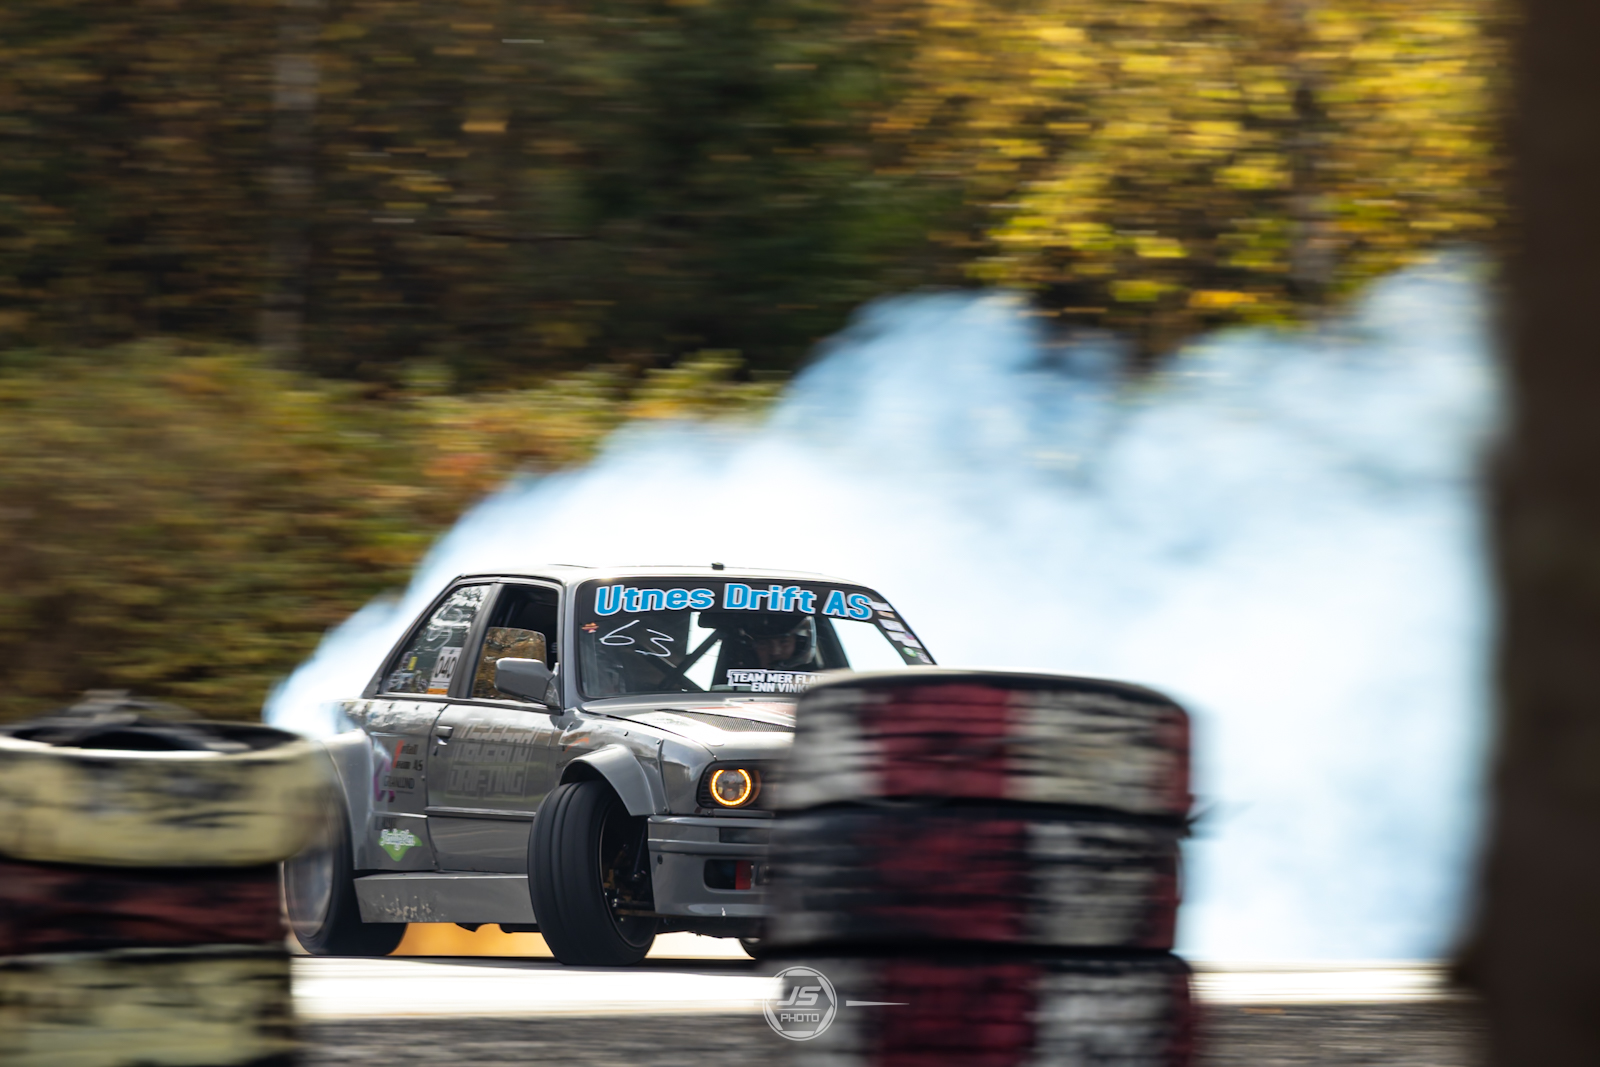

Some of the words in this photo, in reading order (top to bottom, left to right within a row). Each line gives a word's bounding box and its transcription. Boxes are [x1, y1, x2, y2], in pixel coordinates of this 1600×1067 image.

[594, 584, 715, 616] Utnes
[723, 583, 816, 616] Drift
[822, 590, 873, 621] AS
[599, 619, 675, 657] 63
[733, 673, 765, 682] TEAM
[767, 674, 793, 684] MER
[751, 682, 775, 692] ENN
